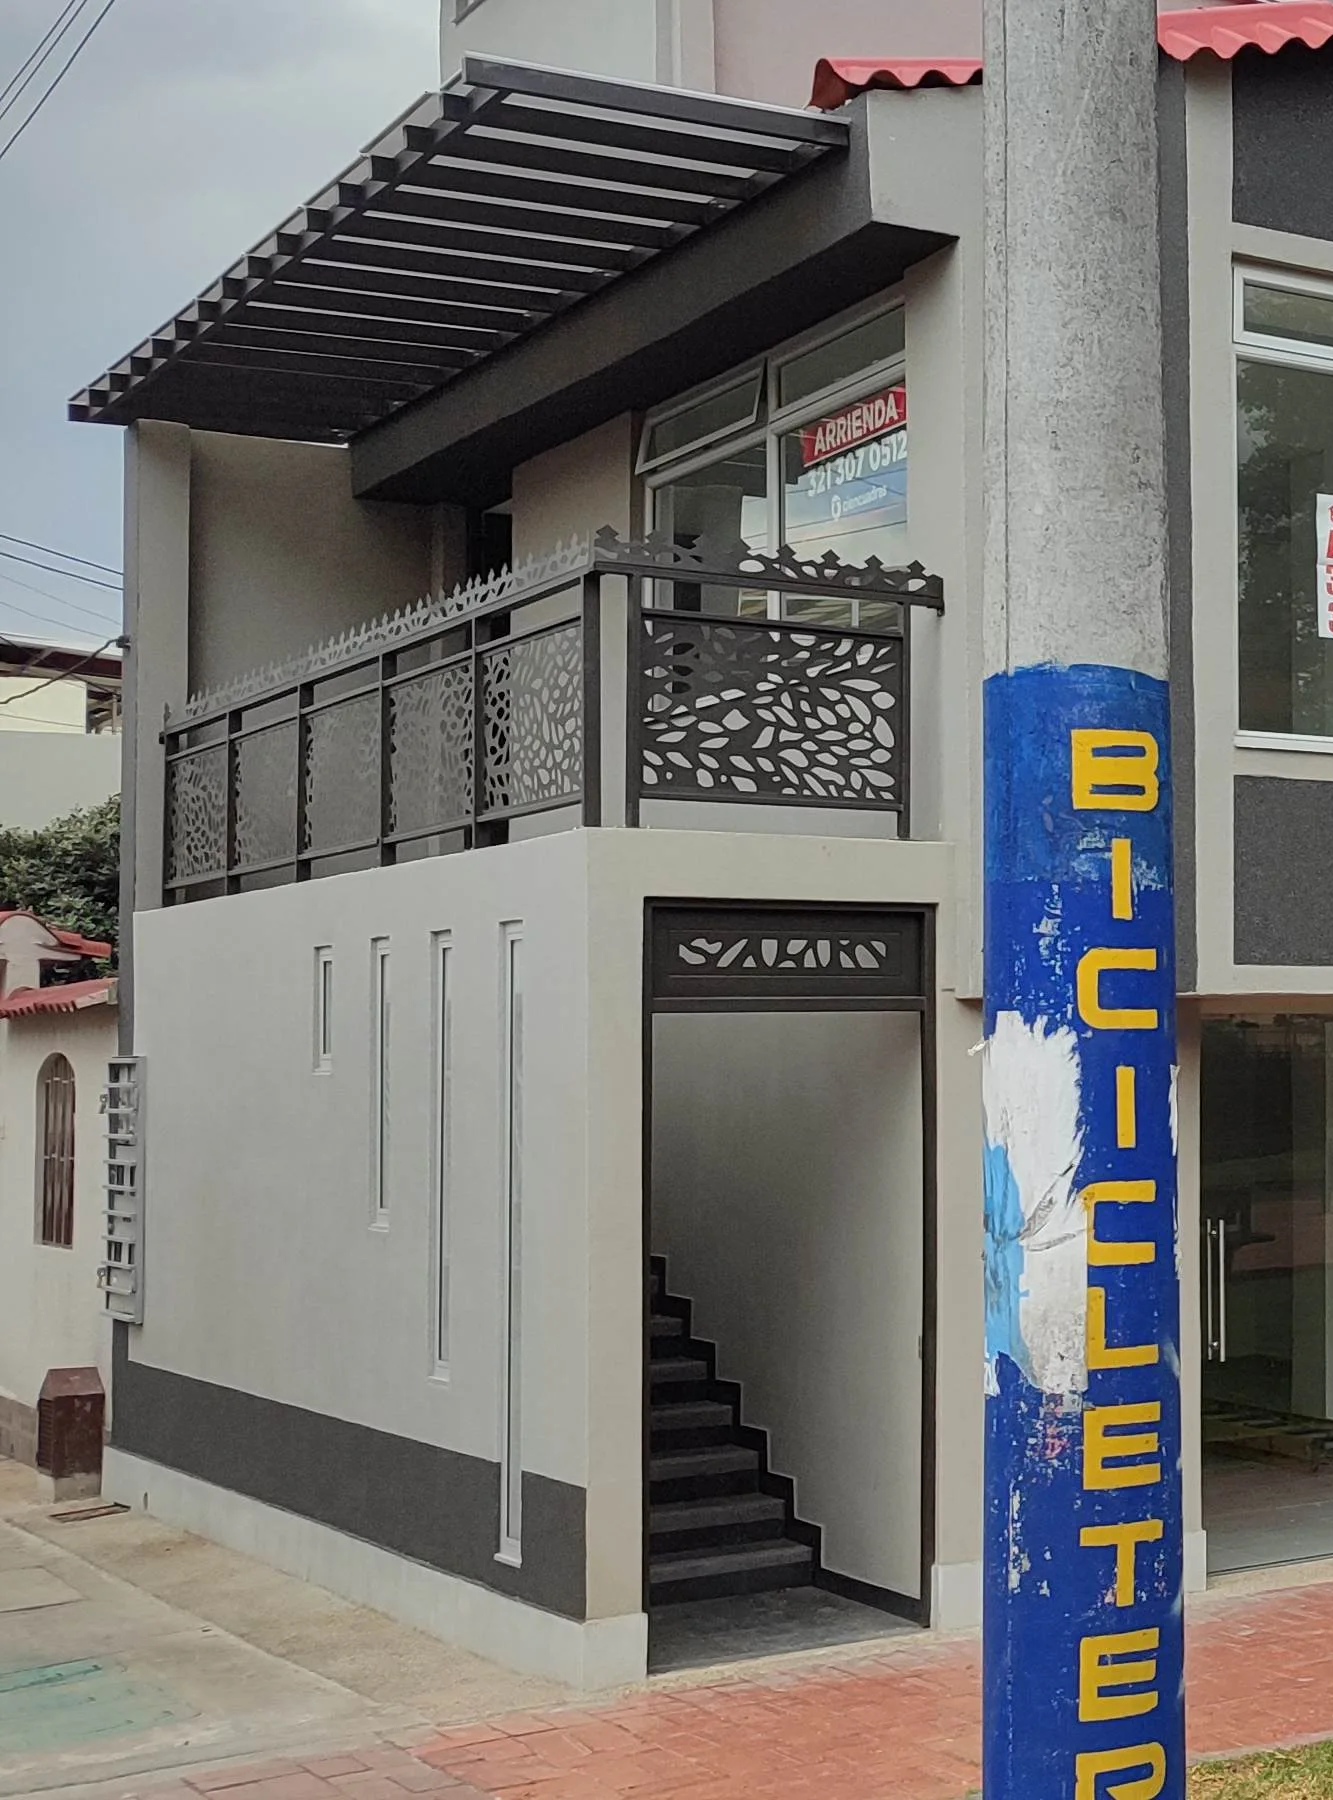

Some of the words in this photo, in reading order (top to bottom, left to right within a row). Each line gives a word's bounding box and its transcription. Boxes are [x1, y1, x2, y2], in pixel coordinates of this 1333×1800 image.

[814, 393, 898, 456] ARRIENDA
[807, 463, 832, 497] 321
[834, 447, 867, 486] 307
[868, 430, 907, 472] 0512
